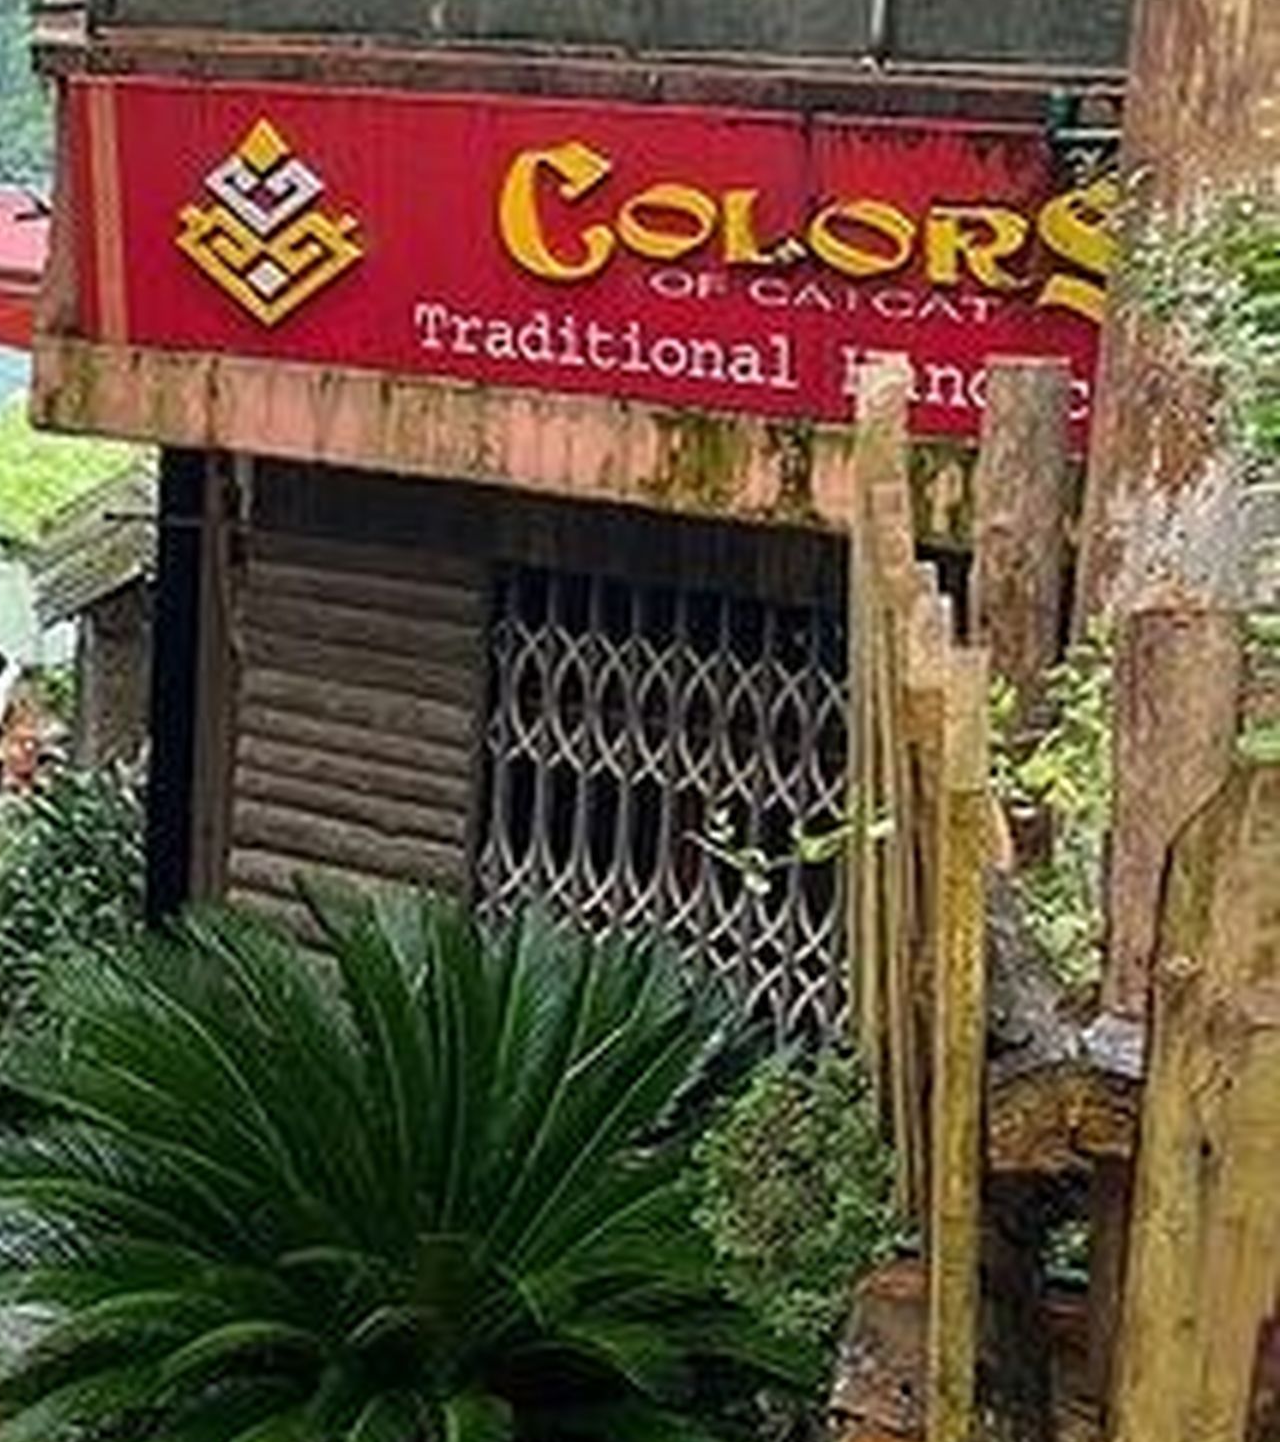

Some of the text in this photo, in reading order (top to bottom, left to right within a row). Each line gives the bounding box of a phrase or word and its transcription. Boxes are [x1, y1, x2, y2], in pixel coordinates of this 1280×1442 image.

[499, 141, 1122, 323] COLORS
[649, 269, 727, 300] OF
[413, 303, 799, 389] Traditional
